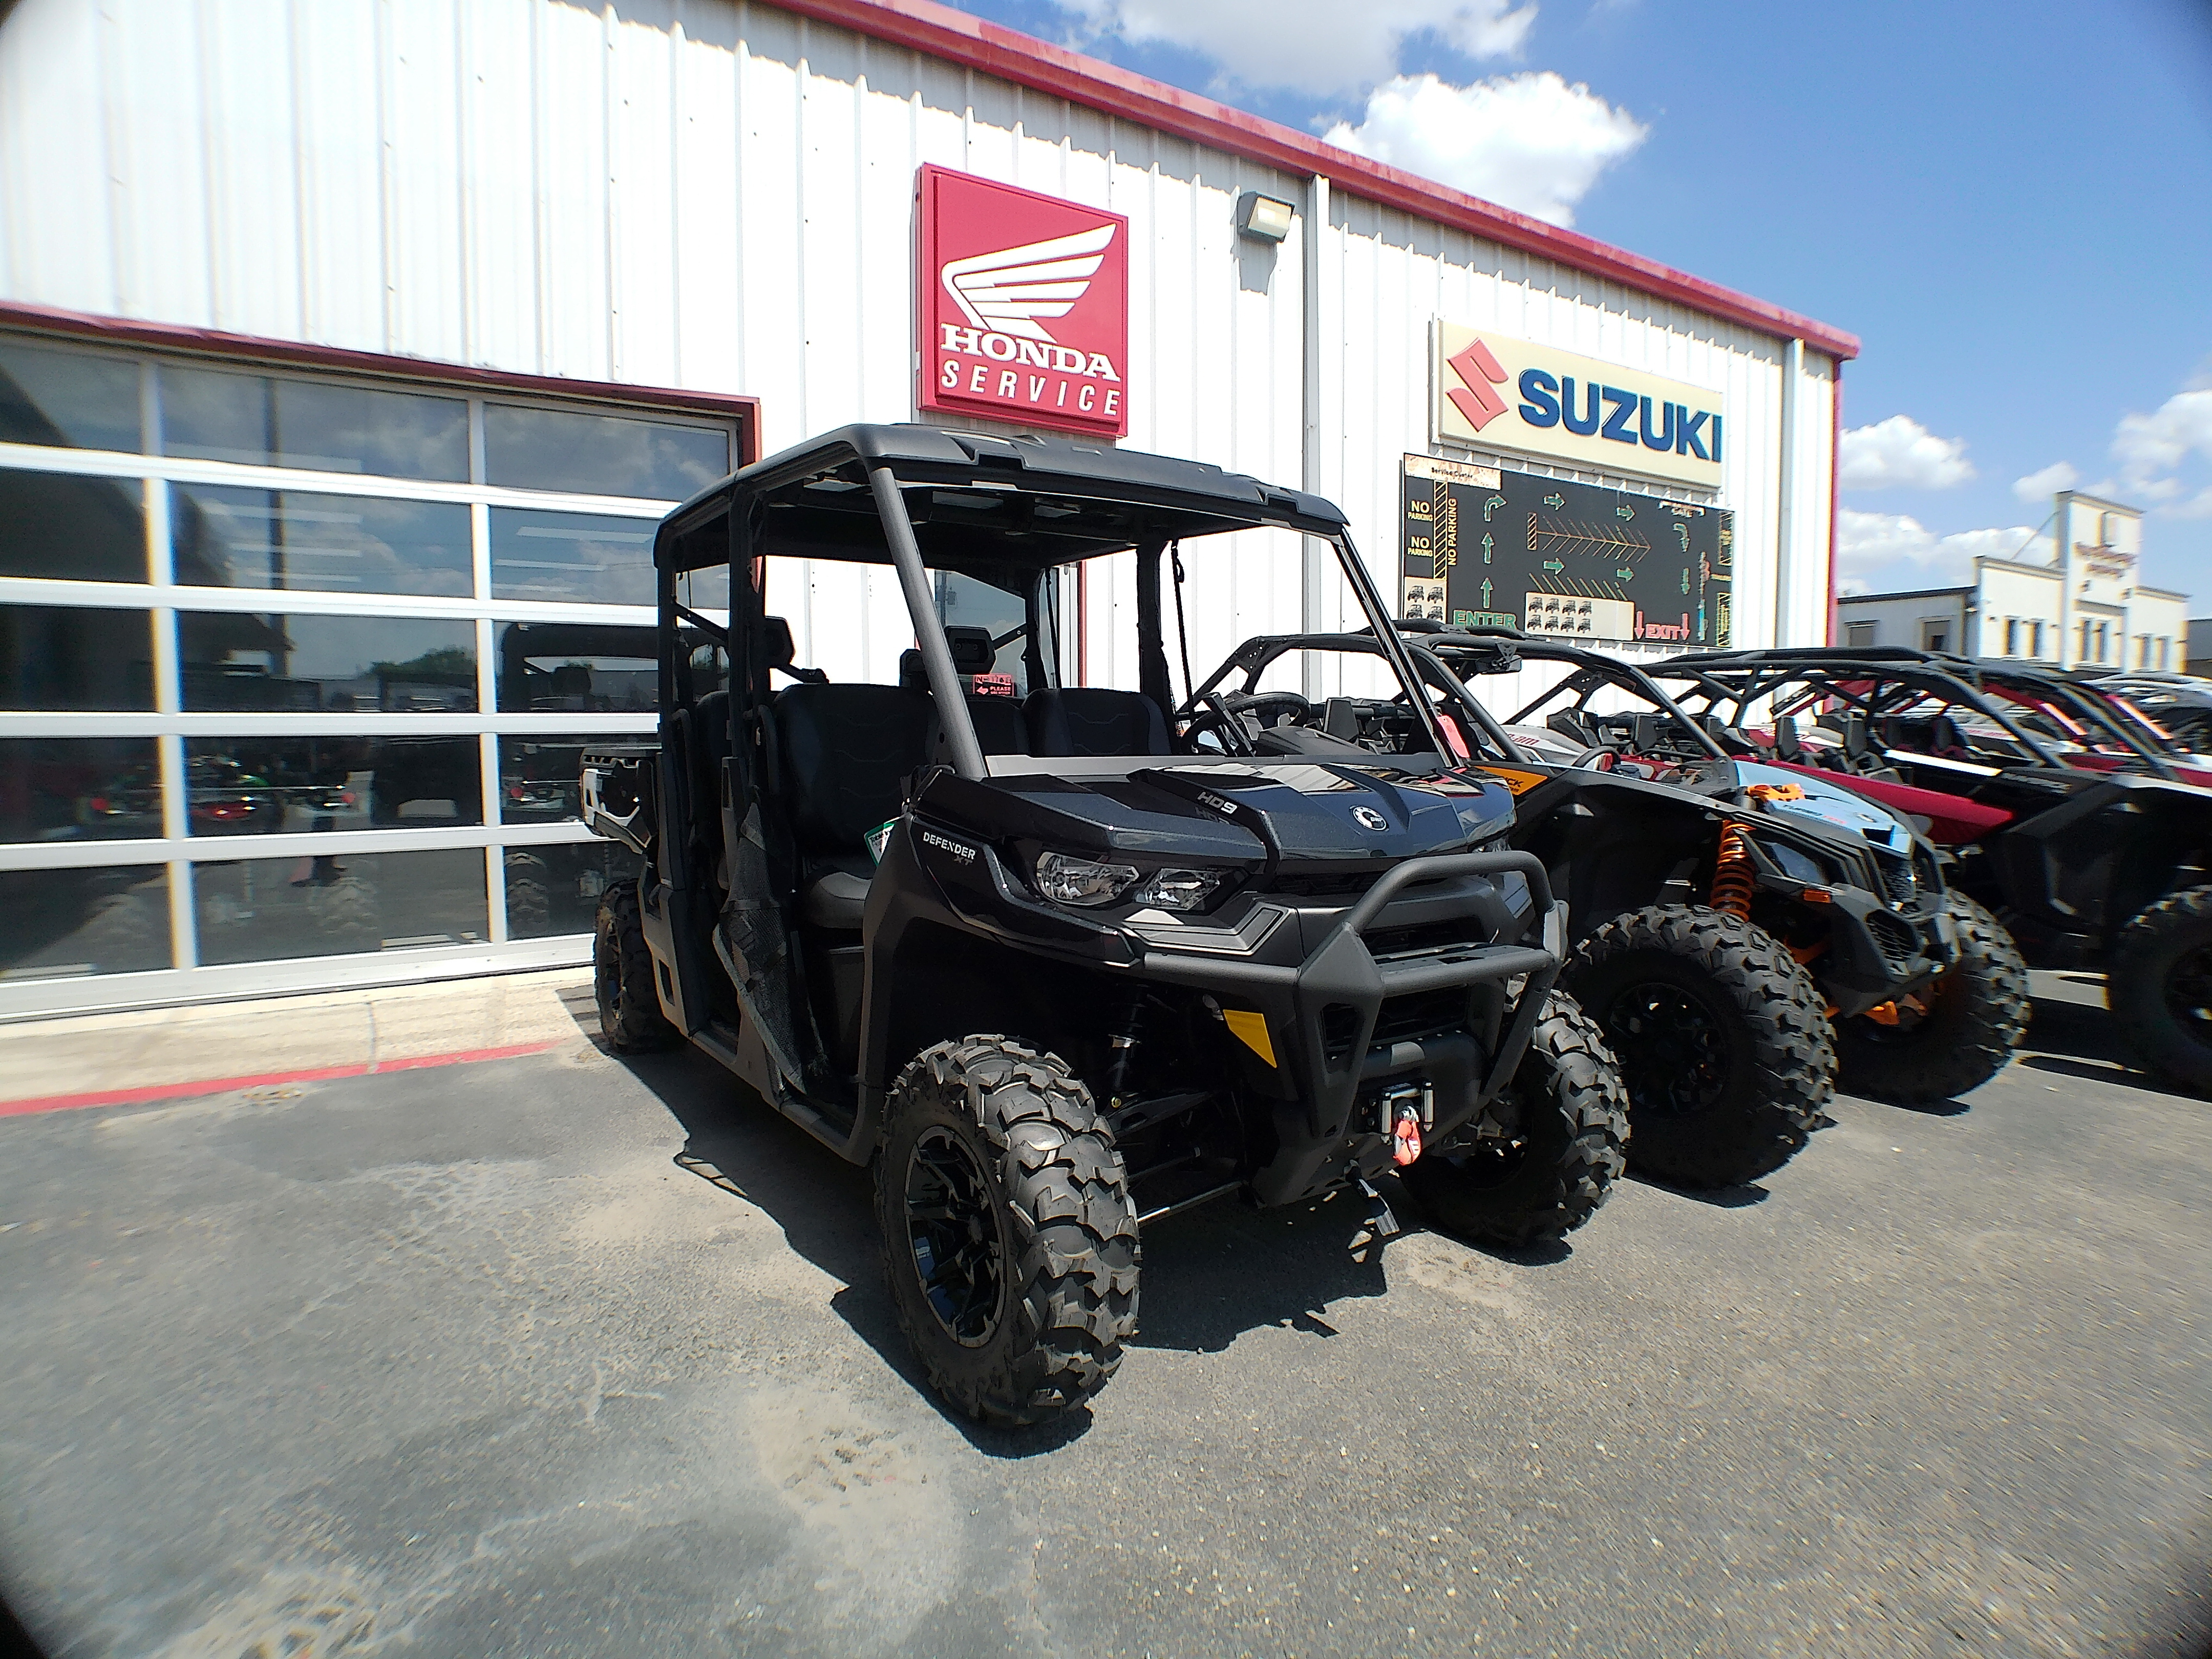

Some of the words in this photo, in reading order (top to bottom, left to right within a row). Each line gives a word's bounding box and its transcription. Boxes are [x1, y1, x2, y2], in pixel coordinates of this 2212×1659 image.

[941, 323, 1121, 382] HONDA
[941, 359, 1120, 416] SERVICE
[1518, 368, 1722, 463] SUZUKI
[1411, 500, 1430, 513] NO
[1408, 512, 1433, 522] PARKING
[1447, 498, 1457, 547] PARKING
[1411, 536, 1430, 549] NO
[1407, 547, 1433, 557] PARKING
[1447, 548, 1457, 566] NO
[1453, 610, 1517, 629] ENTER
[1645, 624, 1681, 640] EXIT
[1197, 792, 1238, 814] HD9
[923, 831, 975, 860] DEFENDER
[954, 855, 973, 865] XT
